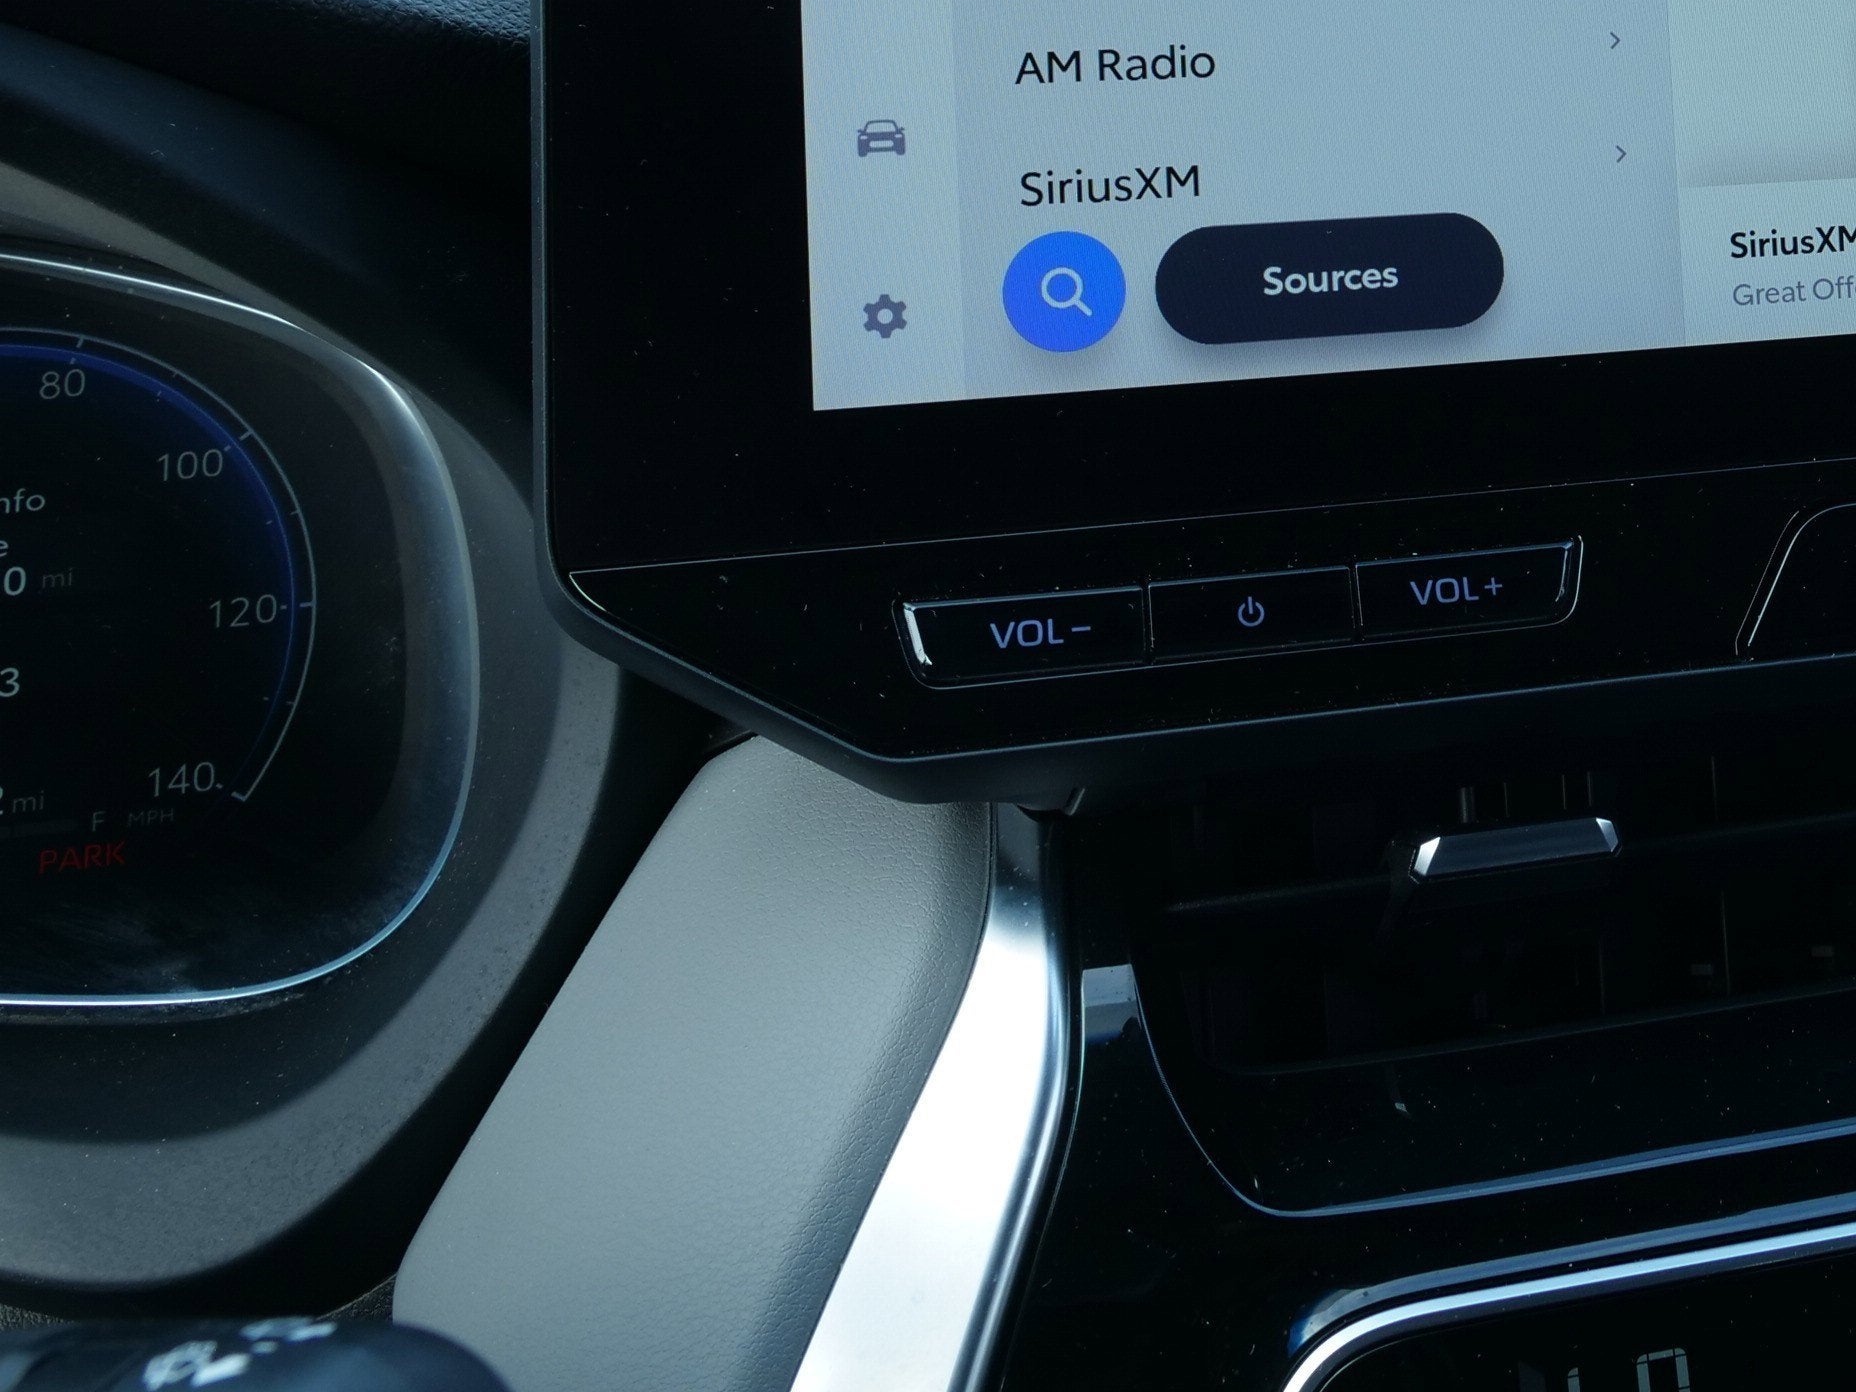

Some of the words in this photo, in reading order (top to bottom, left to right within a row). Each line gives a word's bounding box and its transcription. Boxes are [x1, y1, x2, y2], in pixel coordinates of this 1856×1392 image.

[1014, 50, 1083, 85] AM
[1098, 44, 1216, 82] Radio
[1019, 164, 1201, 208] SiriusXM
[1262, 264, 1400, 297] Sources
[1732, 280, 1807, 306] Great
[39, 368, 86, 400] 80
[156, 449, 224, 483] 100
[41, 567, 74, 589] mi
[209, 593, 278, 629] 120
[147, 761, 216, 798] 140
[12, 790, 45, 814] mi
[91, 810, 107, 833] F
[127, 807, 175, 829] MPH
[37, 839, 127, 876] PARK
